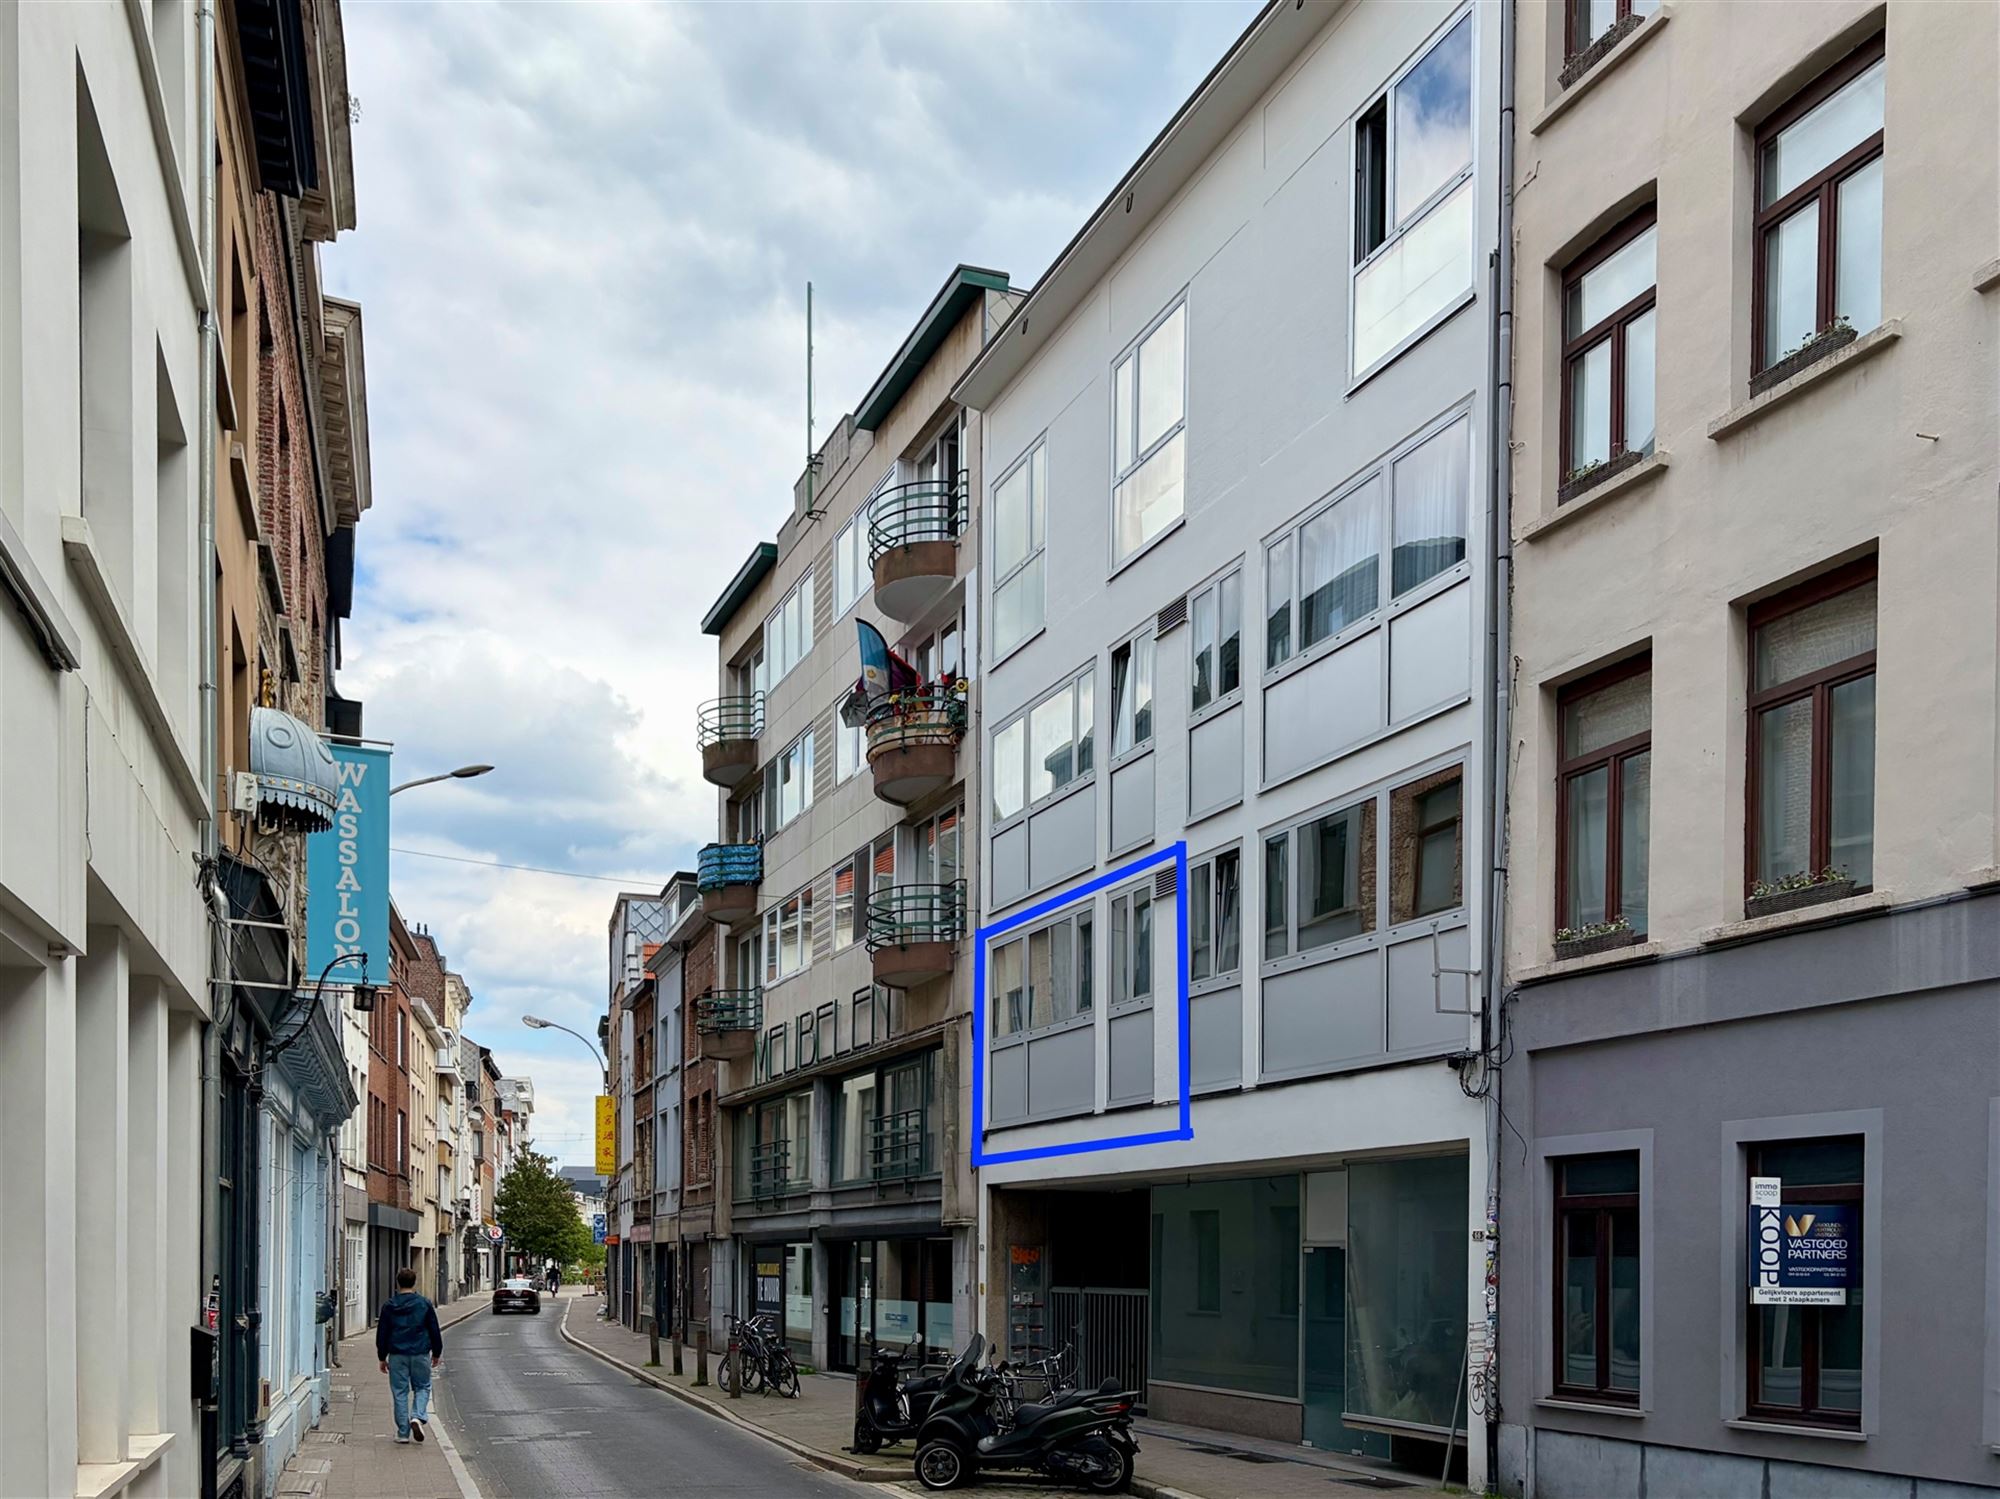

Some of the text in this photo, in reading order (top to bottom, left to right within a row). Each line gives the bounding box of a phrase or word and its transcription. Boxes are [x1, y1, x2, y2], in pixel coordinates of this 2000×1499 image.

[333, 761, 367, 969] WASSALON
[754, 984, 891, 1086] MEUBELEN
[1755, 1181, 1778, 1190] immo
[1755, 1190, 1778, 1198] scoop
[1760, 1206, 1780, 1285] KOOP
[1788, 1239, 1848, 1249] VASTGOED
[1788, 1250, 1848, 1260] PARTNERS
[1758, 1289, 1797, 1297] Gelijkvloers
